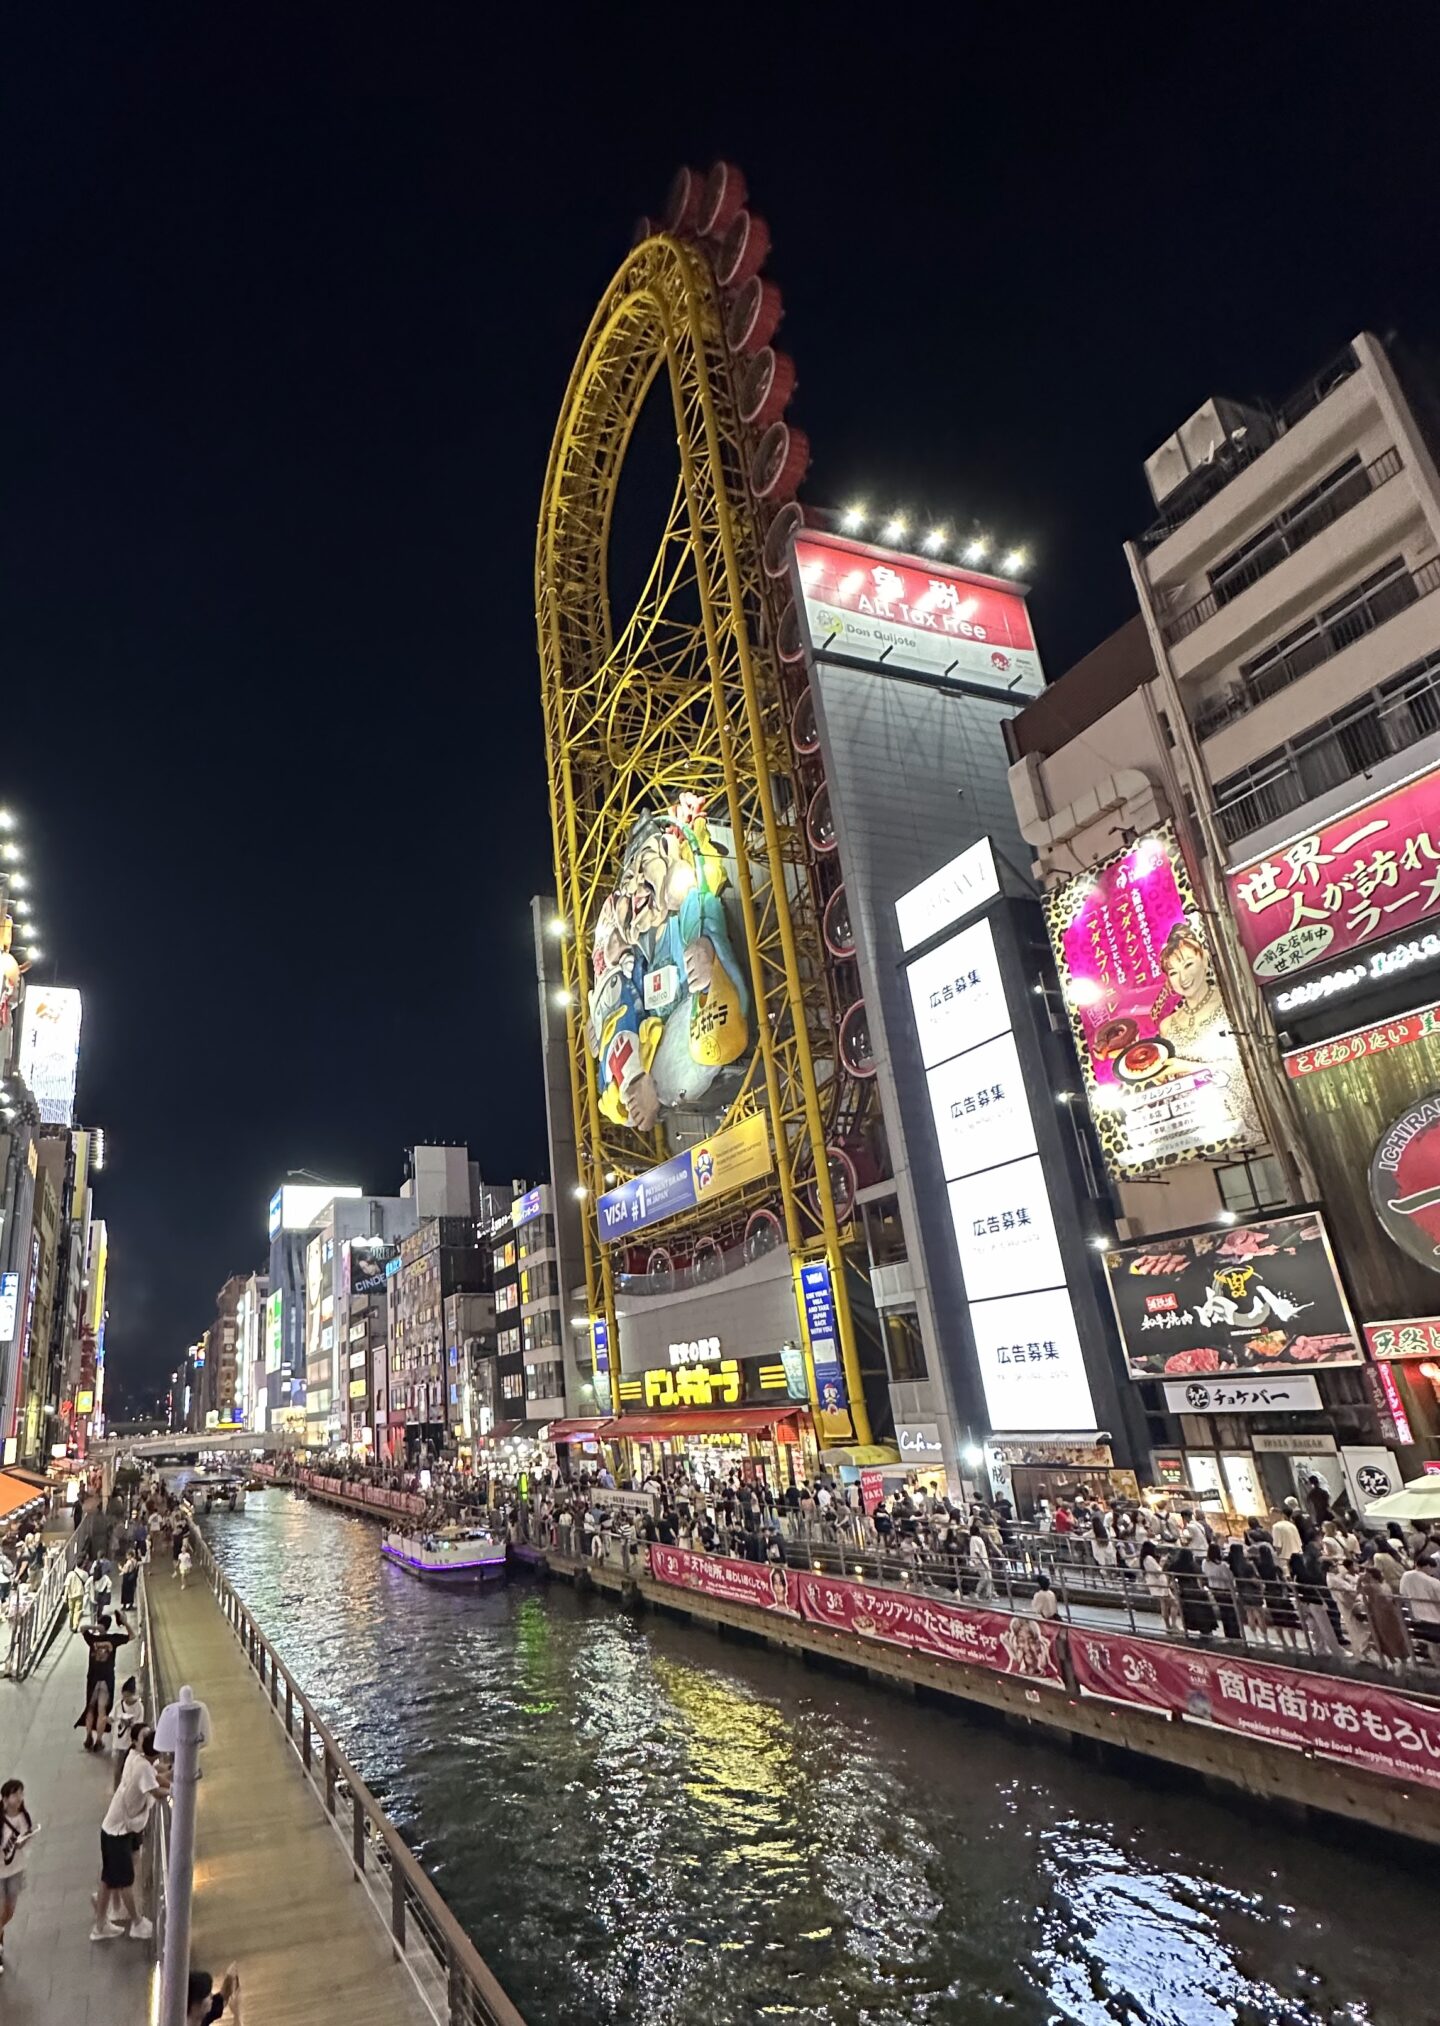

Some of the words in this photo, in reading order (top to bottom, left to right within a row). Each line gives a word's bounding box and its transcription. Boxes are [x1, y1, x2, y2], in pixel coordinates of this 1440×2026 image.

[899, 603, 937, 628] Tax
[846, 624, 871, 639] Don
[873, 630, 917, 648] Quijote
[1237, 819, 1389, 913] 世界一
[929, 969, 981, 1008] 広告募集
[1297, 1025, 1409, 1073] こだわりたい
[950, 1083, 1005, 1119] 広告募集
[603, 1202, 628, 1226] VISA
[631, 1184, 646, 1222] #1
[972, 1207, 1032, 1236] 広告募集
[997, 1341, 1060, 1364] 広告募集
[1213, 1388, 1290, 1406] チョケバー
[1315, 1737, 1330, 1749] the
[1331, 1740, 1353, 1753] local
[1355, 1746, 1394, 1767] shopping
[1395, 1759, 1425, 1774] streets
